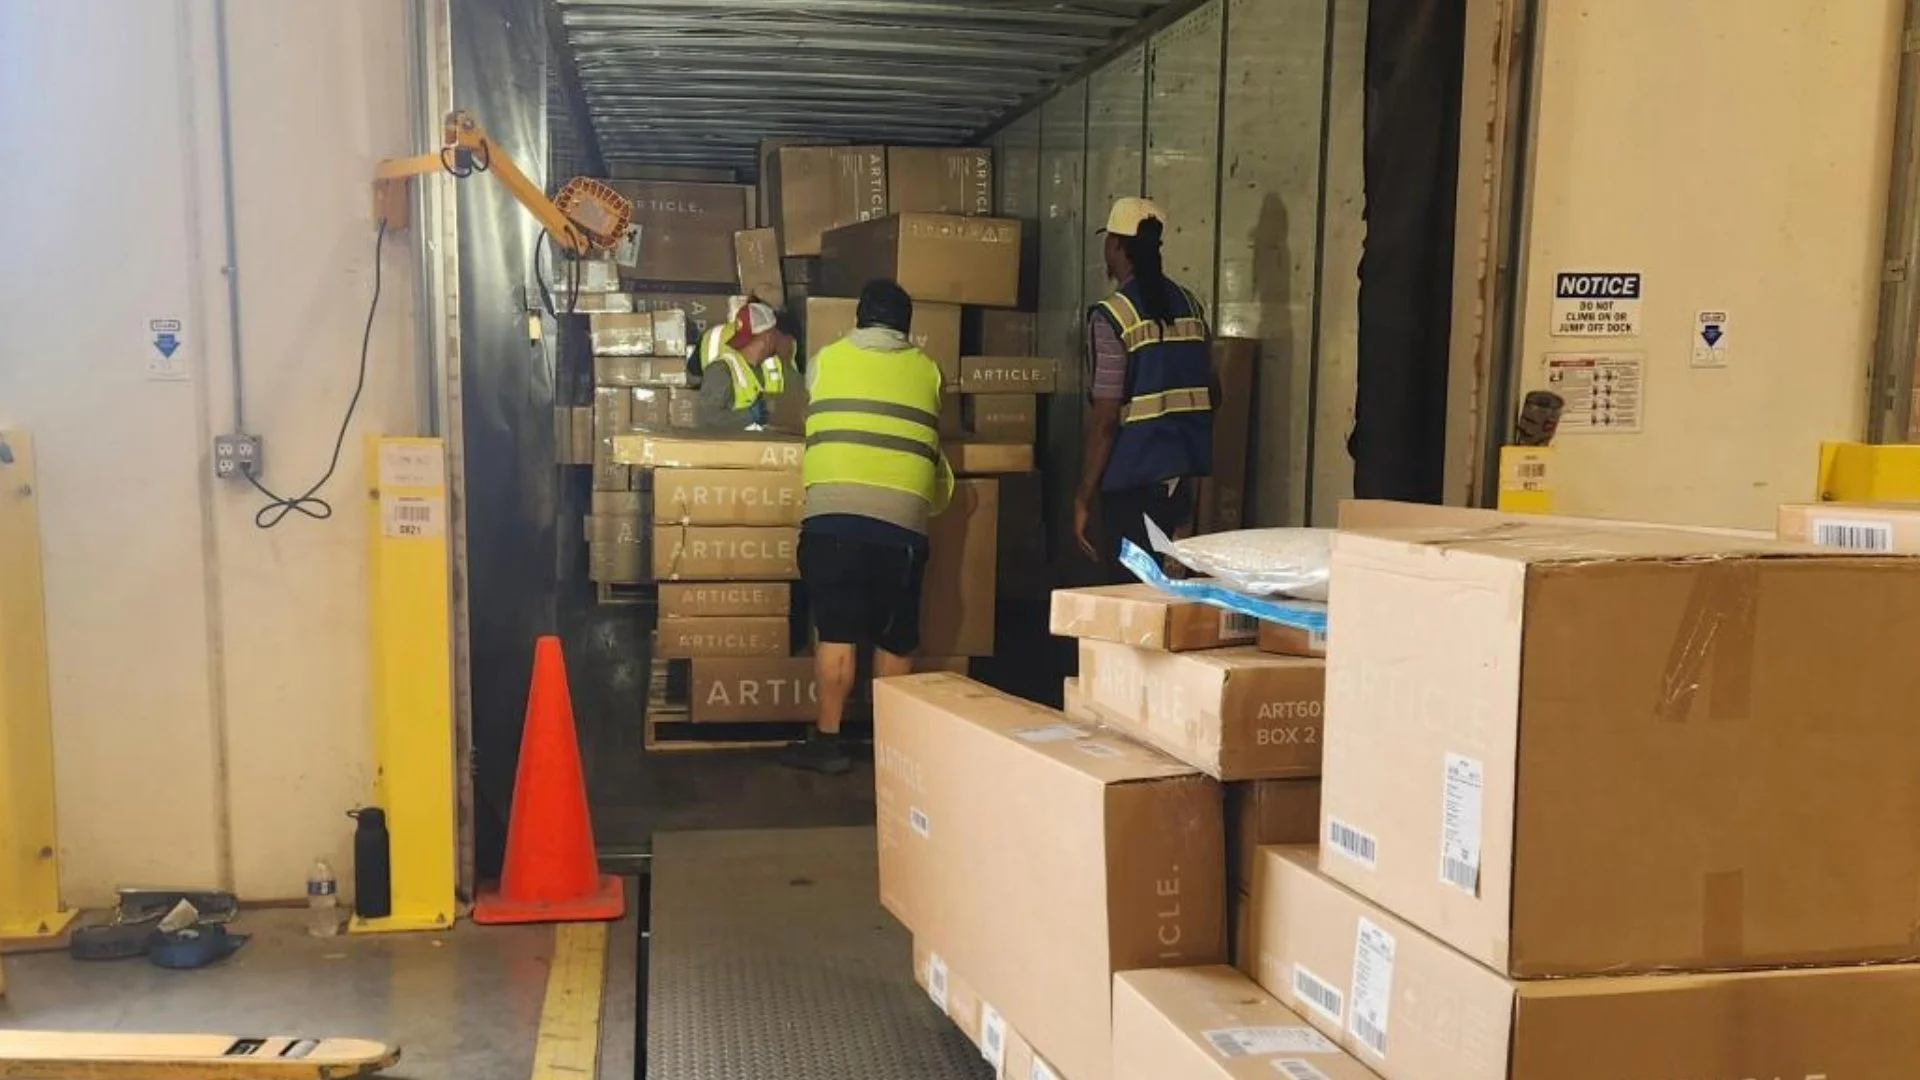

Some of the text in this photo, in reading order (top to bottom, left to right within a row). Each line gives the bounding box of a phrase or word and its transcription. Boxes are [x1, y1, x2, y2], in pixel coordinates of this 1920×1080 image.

[1560, 276, 1637, 295] NOTICE
[1579, 301, 1614, 311] DO NOT
[1566, 312, 1627, 321] CLIMB ON OR
[1559, 323, 1632, 332] JUMP OFF DOCK
[972, 368, 1047, 381] ARTICLE.
[1257, 727, 1316, 745] BOX 2
